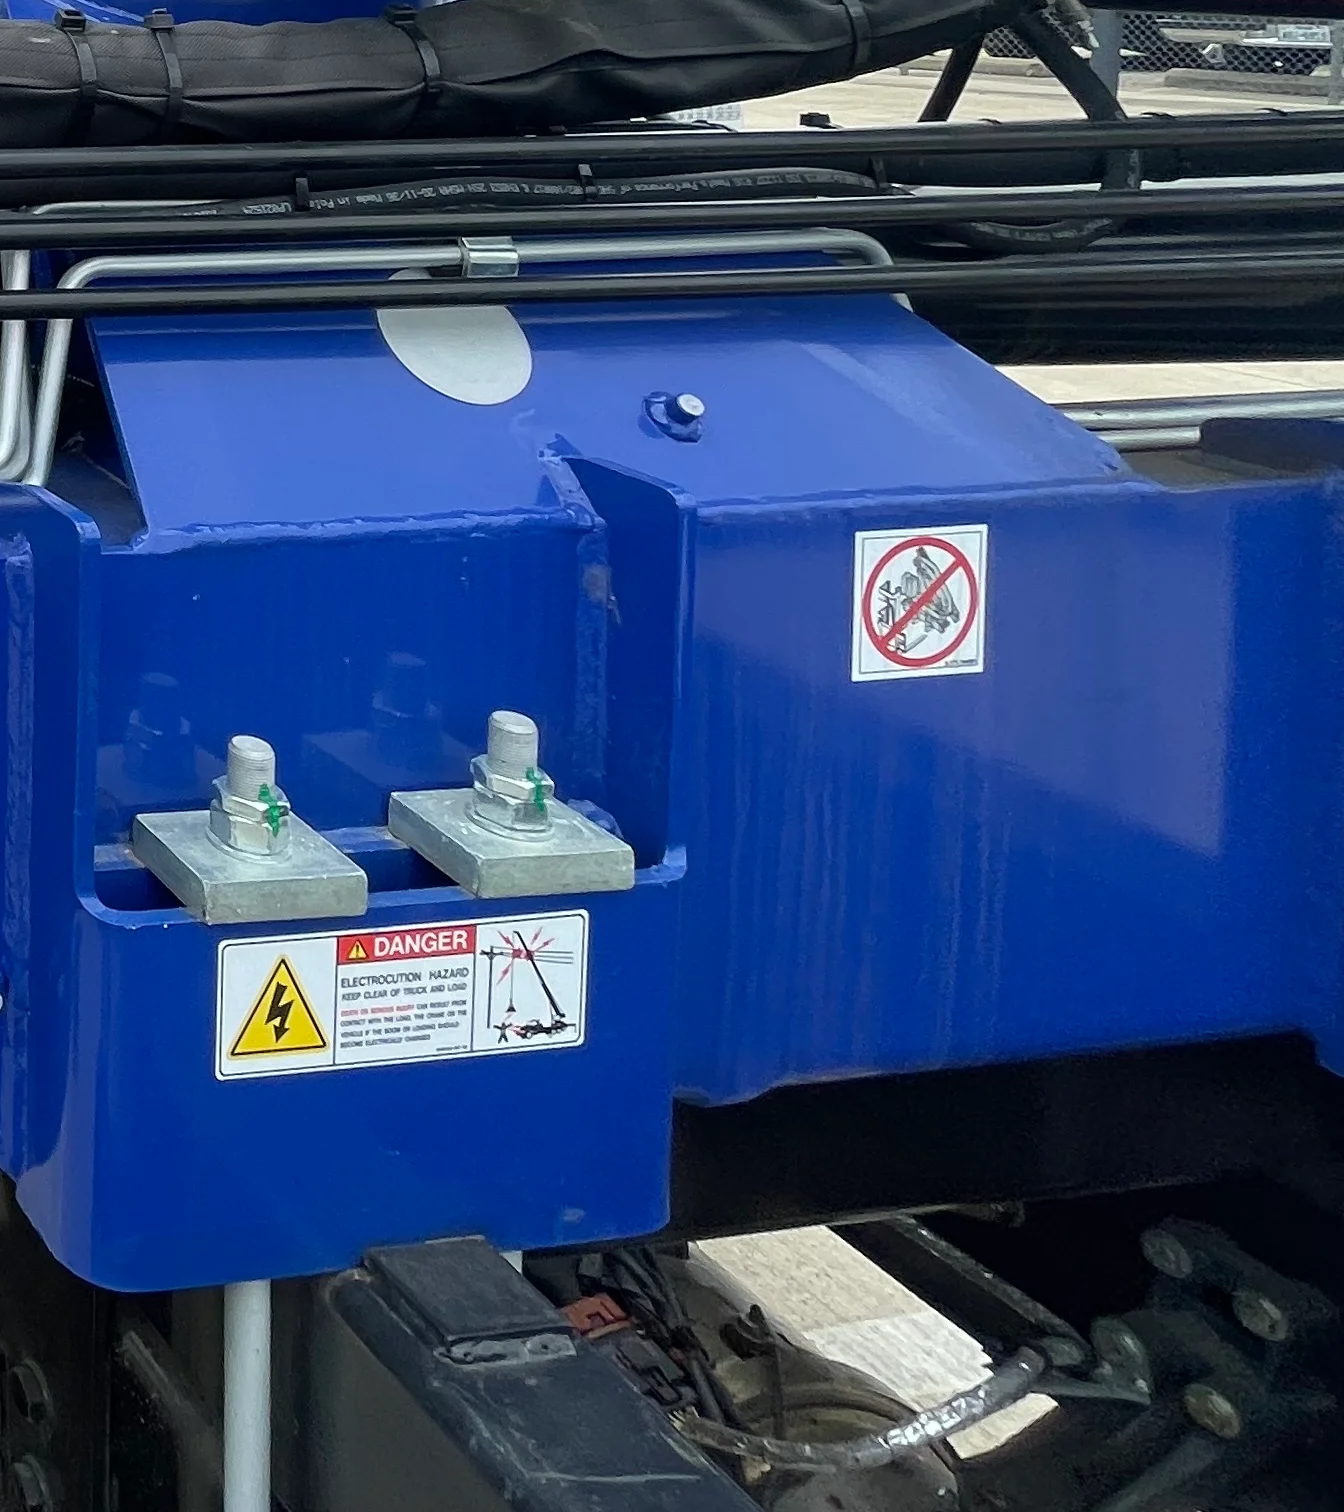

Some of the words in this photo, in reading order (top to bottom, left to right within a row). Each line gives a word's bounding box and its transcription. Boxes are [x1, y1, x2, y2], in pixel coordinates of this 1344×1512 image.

[373, 930, 468, 957] DANGER
[341, 972, 422, 988] ELECTROCUTION
[429, 968, 470, 981] HAZARD
[363, 989, 387, 1000] CLEAR
[390, 988, 401, 997] OF
[430, 984, 446, 993] AND
[447, 983, 468, 991] LOAD
